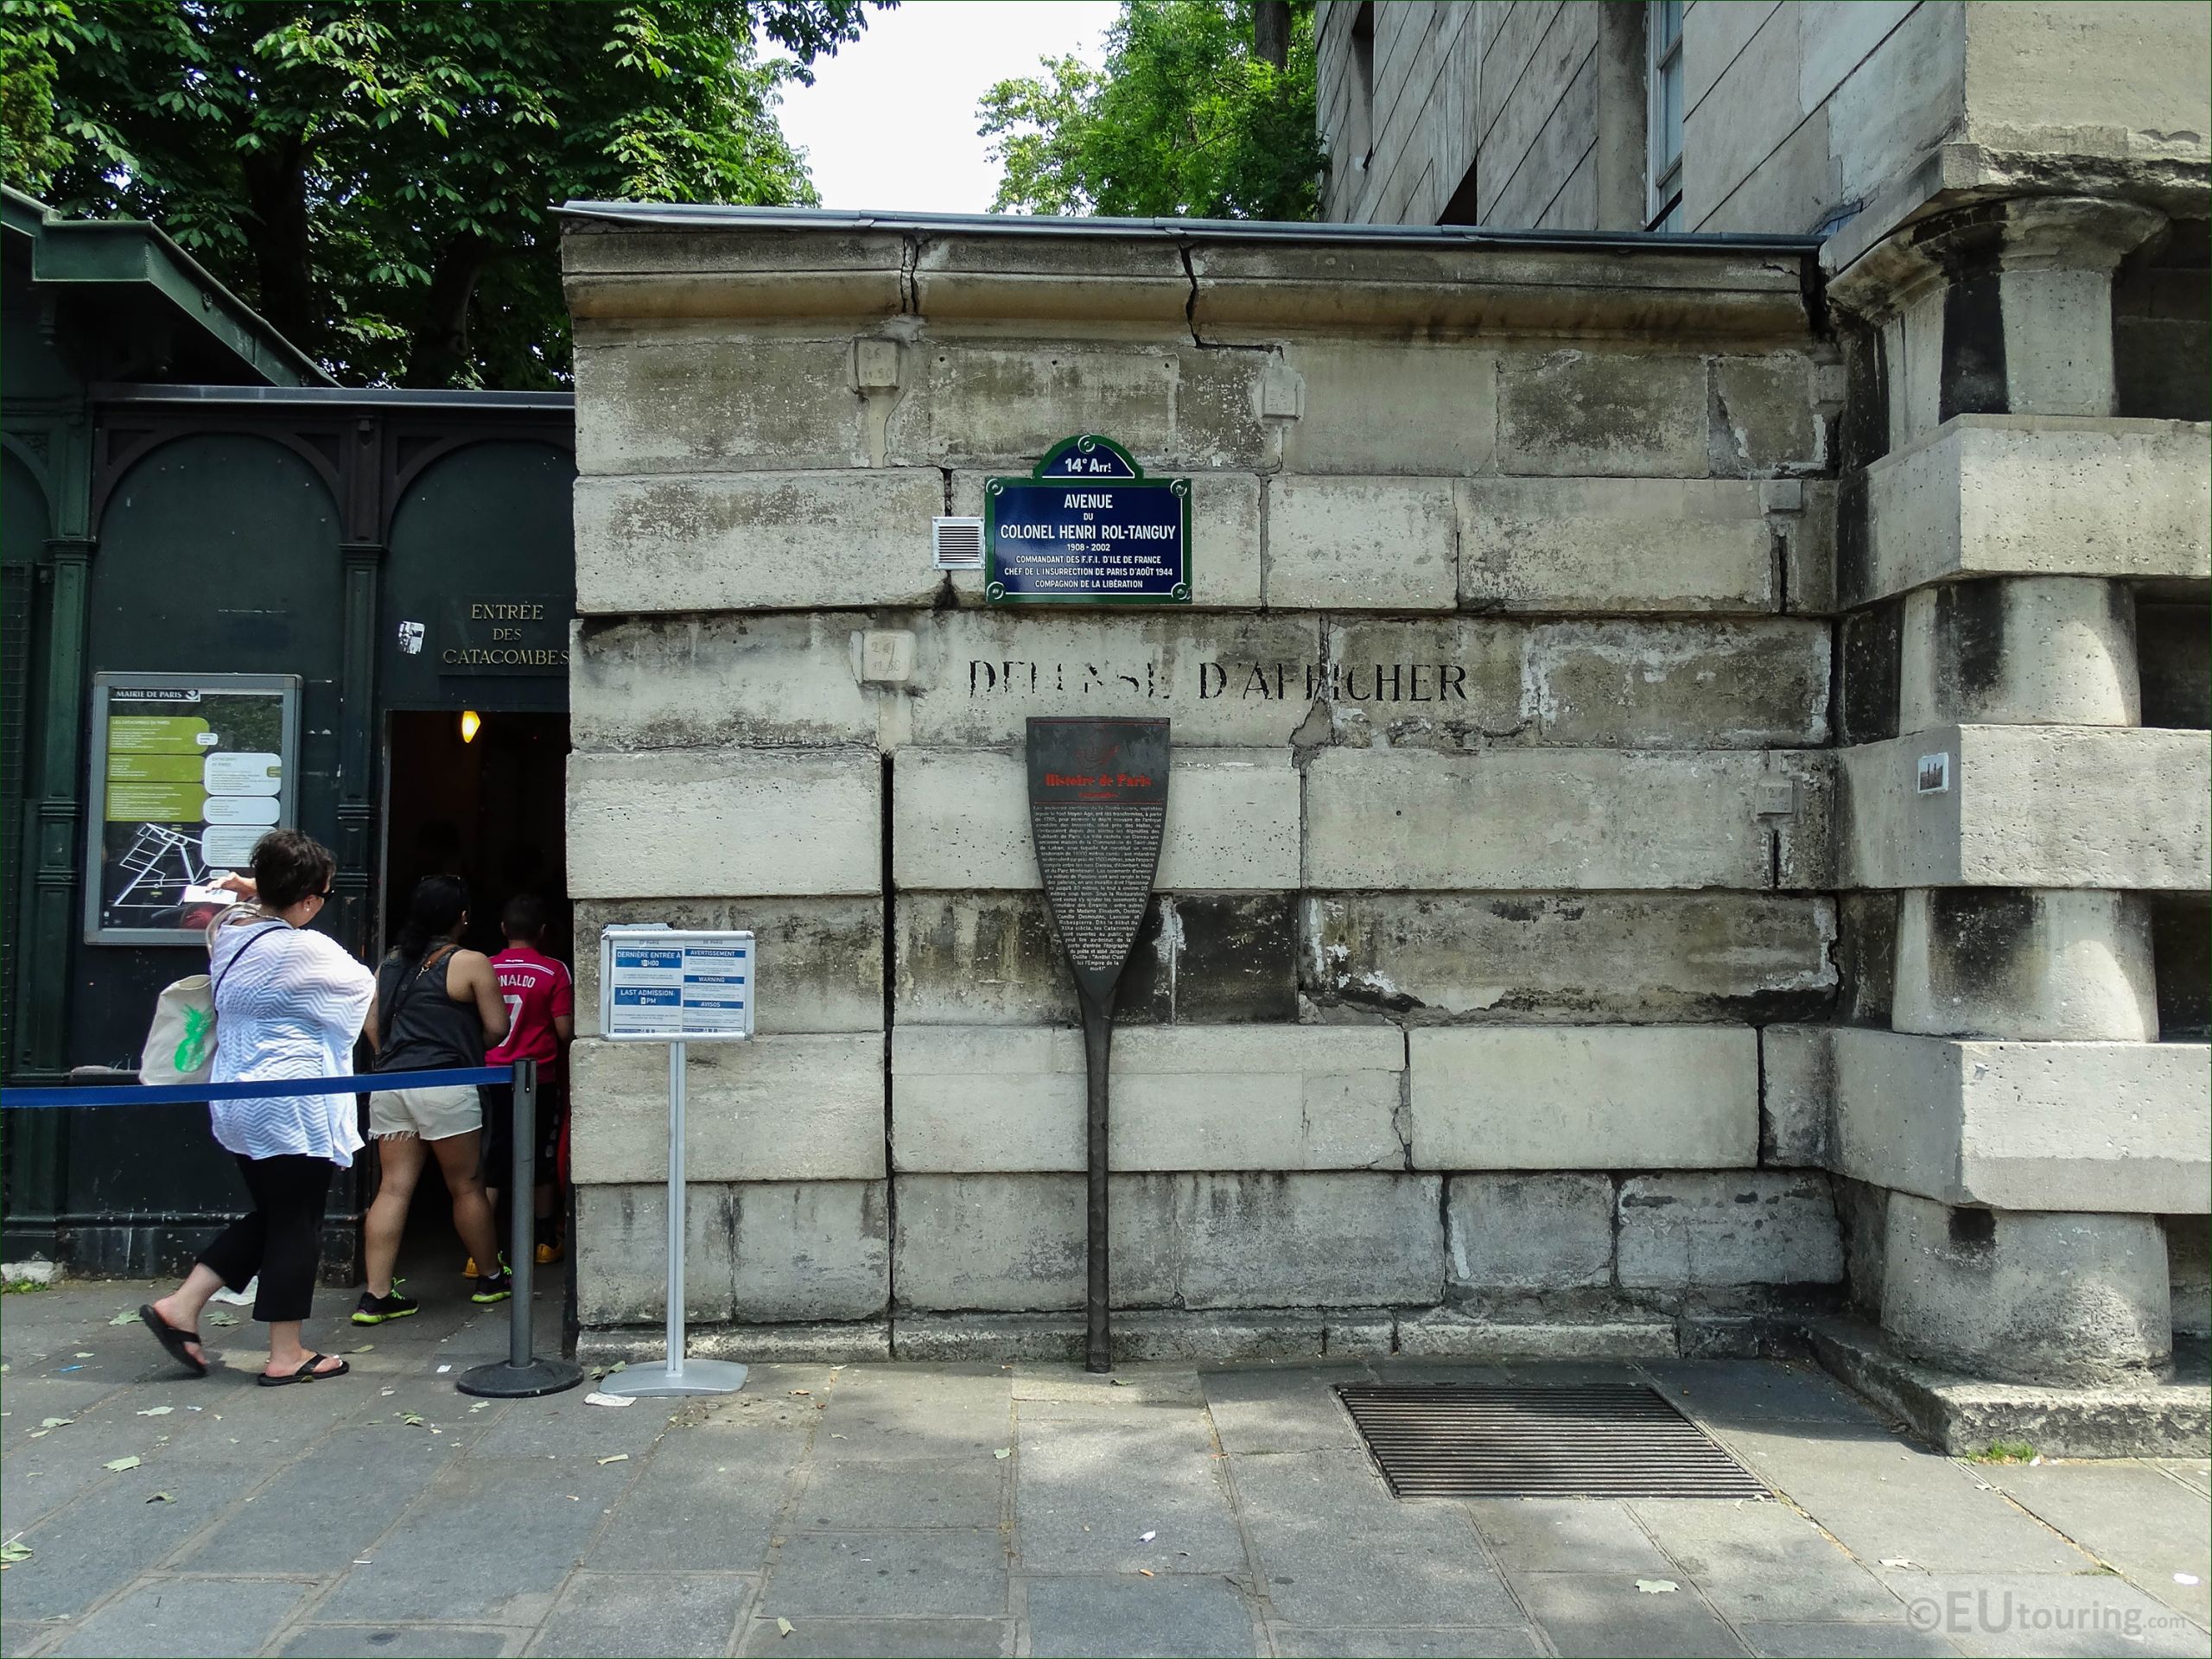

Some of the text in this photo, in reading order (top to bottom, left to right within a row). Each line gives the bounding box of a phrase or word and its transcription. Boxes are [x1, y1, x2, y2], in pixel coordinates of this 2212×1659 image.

[1064, 494, 1113, 509] AVENUE
[1083, 512, 1094, 521] DU
[1001, 524, 1176, 540] COLONEL HENRI ROL-TANGUY
[1015, 556, 1065, 564] COMMANDANT
[1065, 556, 1080, 564] DES
[1082, 556, 1101, 564] F.F.I.
[1123, 556, 1133, 564] DE
[1134, 556, 1161, 564] FRANCE
[1004, 568, 1021, 576] CHEF
[1106, 568, 1128, 576] PARIS
[1155, 568, 1173, 576] 1944
[1035, 578, 1143, 588] COMPAGNON DE LA LIBÉRATION
[493, 628, 522, 641] DES
[442, 649, 569, 664] CATACOMBES
[1045, 773, 1153, 787] Histoire de Paris
[498, 974, 536, 988] NALDO
[498, 995, 523, 1047] 7
